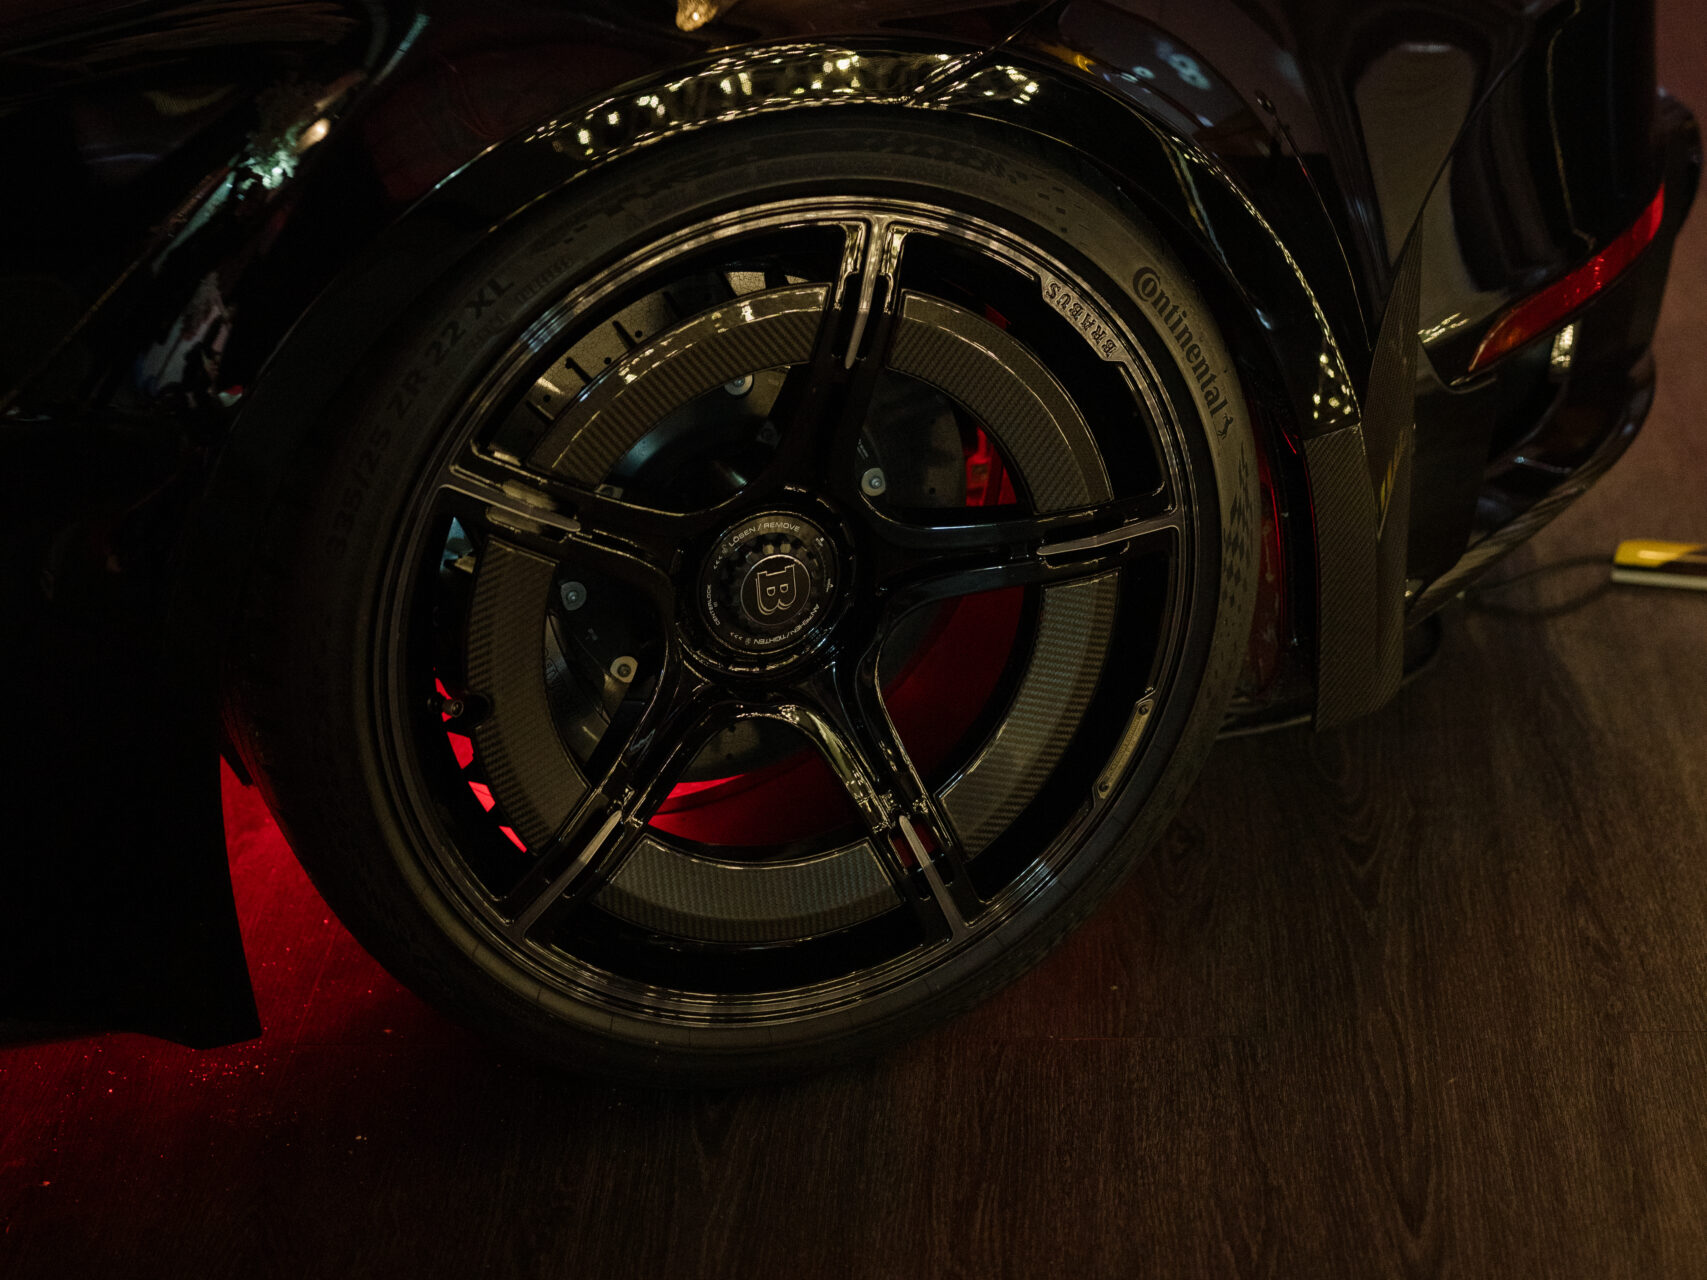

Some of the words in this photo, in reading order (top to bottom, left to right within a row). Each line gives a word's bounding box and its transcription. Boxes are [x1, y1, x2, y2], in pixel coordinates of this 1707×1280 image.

[386, 370, 428, 418] ZR
[427, 319, 466, 364] 22
[466, 278, 515, 318] XL
[1046, 283, 1117, 358] BRABUS
[1132, 266, 1228, 418] Continental
[763, 522, 801, 533] REMOVE
[755, 563, 797, 616] B
